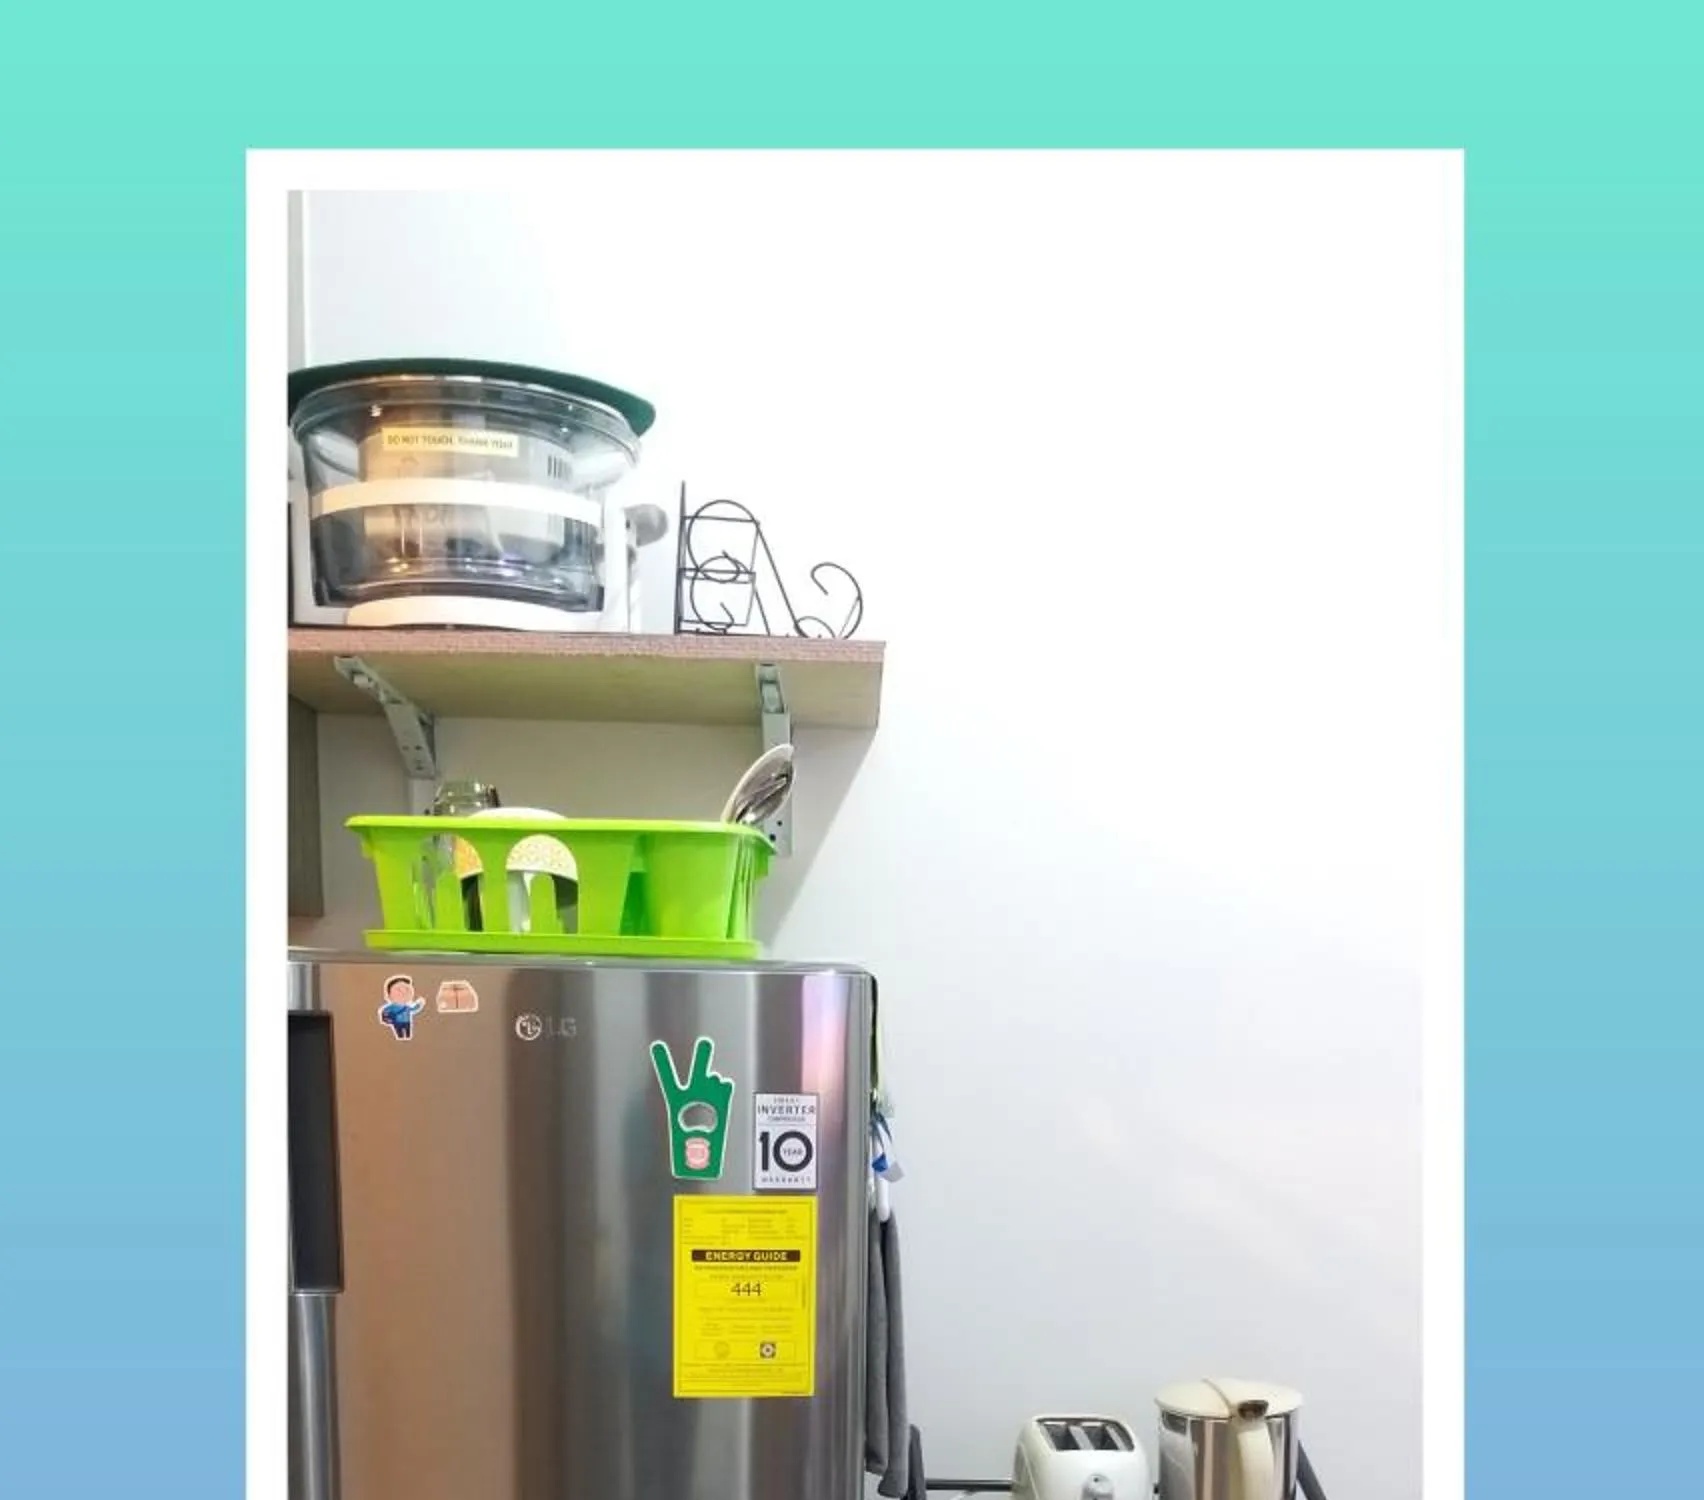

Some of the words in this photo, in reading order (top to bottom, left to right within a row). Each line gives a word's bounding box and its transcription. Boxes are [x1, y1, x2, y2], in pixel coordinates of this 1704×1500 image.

[387, 434, 400, 445] DO
[402, 434, 419, 445] NOT
[757, 1104, 816, 1115] INVERTER
[759, 1131, 813, 1172] 10
[783, 1147, 803, 1156] YEAR
[705, 1251, 752, 1261] ENERGY
[753, 1251, 789, 1261] GUIDE
[731, 1281, 762, 1297] 444
